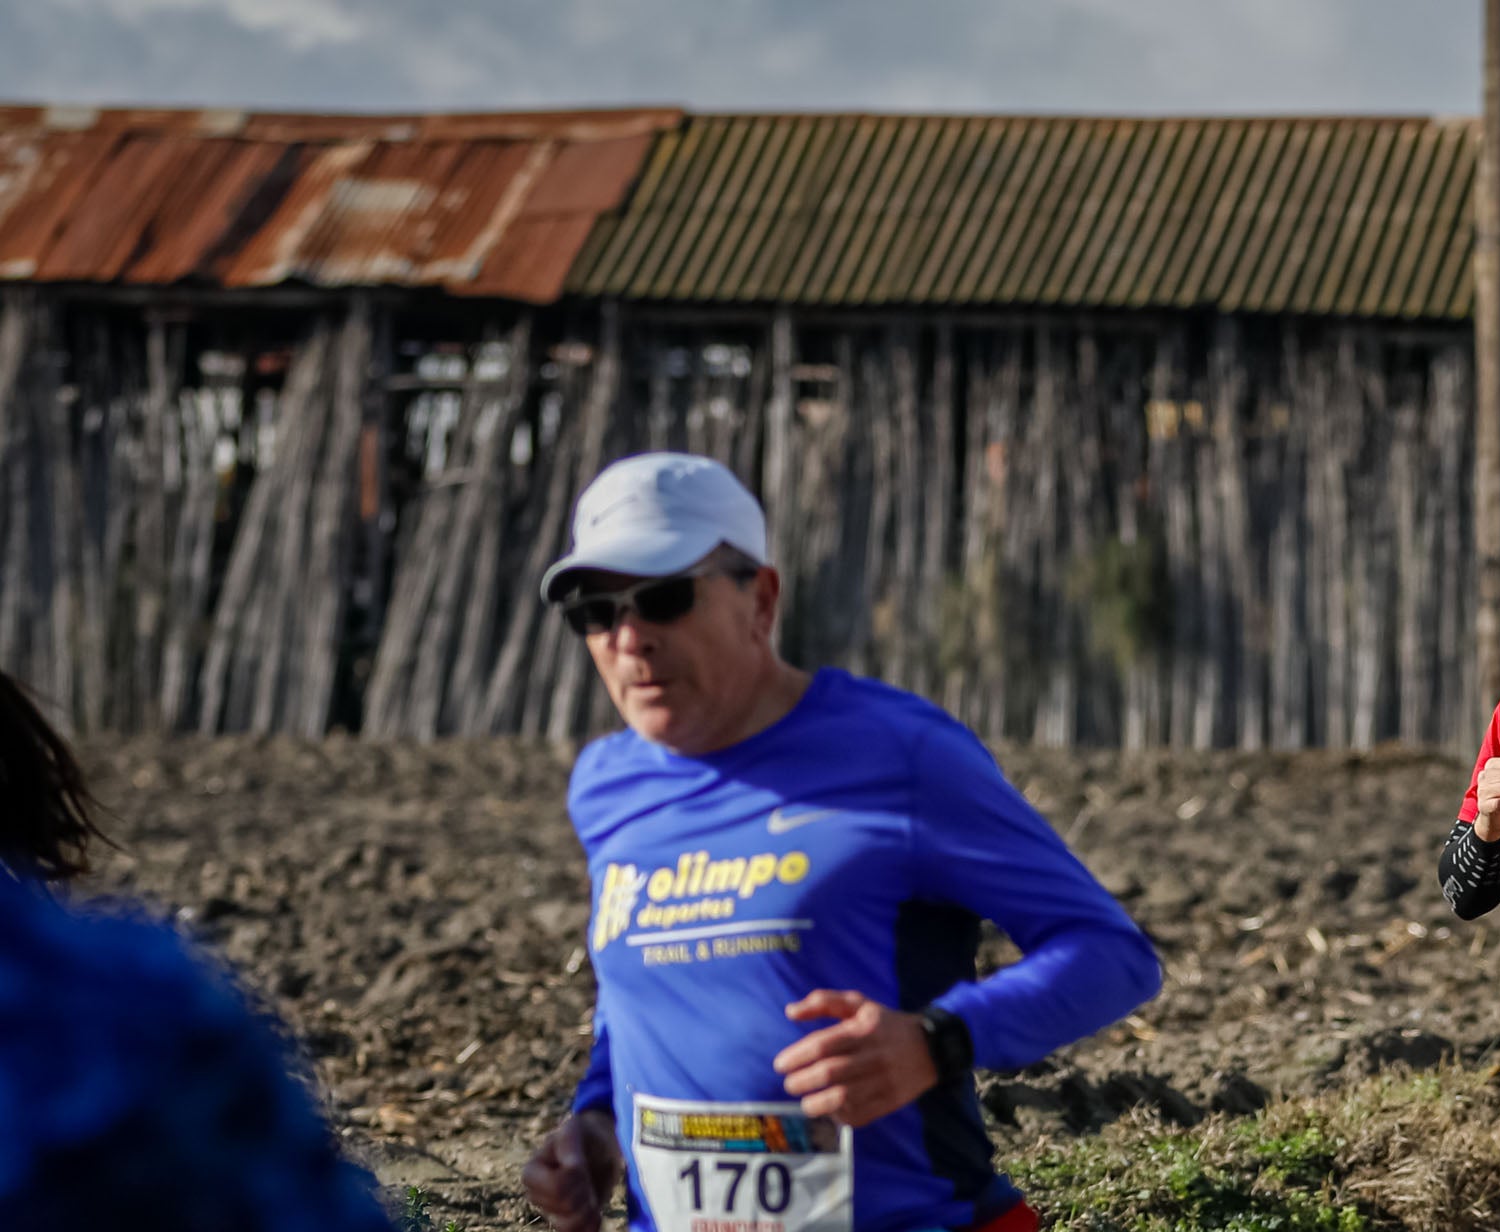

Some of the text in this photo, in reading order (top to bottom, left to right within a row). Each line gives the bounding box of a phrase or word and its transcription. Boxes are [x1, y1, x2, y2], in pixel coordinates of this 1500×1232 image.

[647, 850, 810, 902] olimpo
[642, 944, 693, 967] TRAIL
[696, 941, 711, 961] &
[679, 1159, 792, 1214] 170
